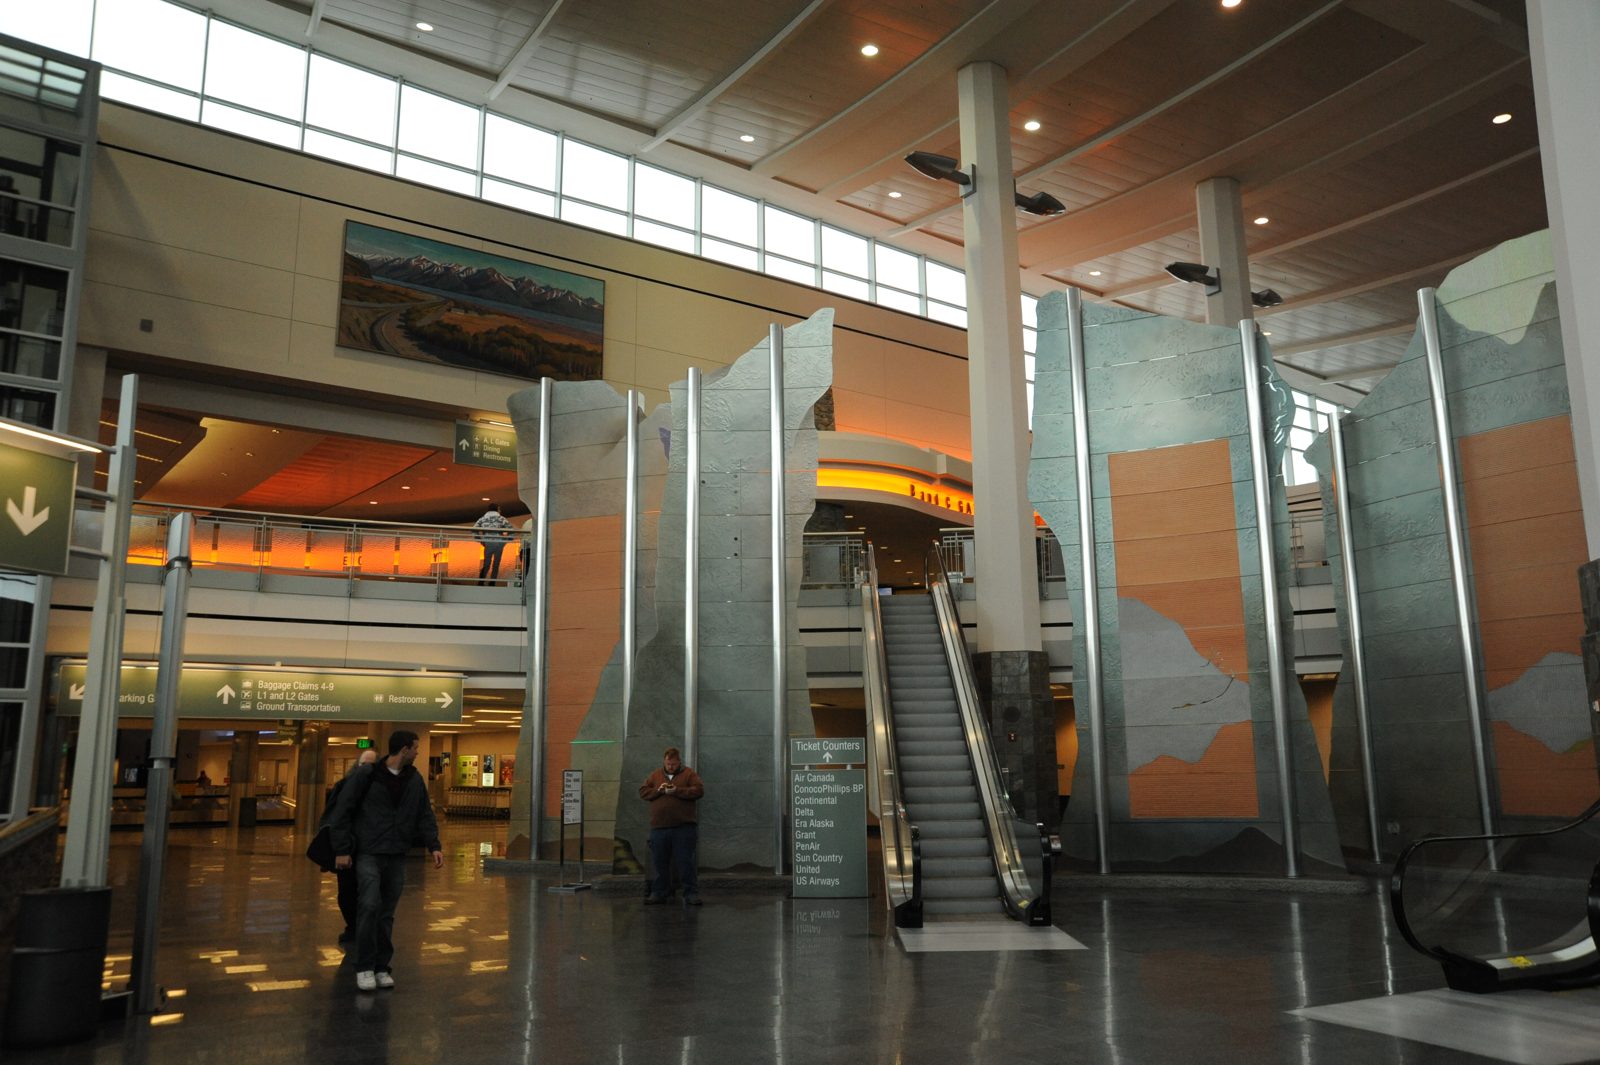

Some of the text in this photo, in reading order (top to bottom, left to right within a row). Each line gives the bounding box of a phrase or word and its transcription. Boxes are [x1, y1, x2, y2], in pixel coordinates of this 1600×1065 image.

[495, 438, 510, 446] Gates
[483, 445, 500, 453] Dining
[483, 452, 511, 462] Restrooms
[910, 484, 915, 496] B
[920, 491, 939, 505] and
[257, 680, 335, 691] Baggage Claims 4-9
[119, 694, 145, 704] arking
[257, 691, 320, 701] L1 and L2 Gates
[388, 694, 427, 704] Restrooms
[256, 702, 341, 713] Ground Transportation
[796, 740, 860, 751] Ticket Counters
[794, 772, 835, 782] Air Canada
[794, 796, 837, 805] Continental
[795, 807, 814, 816] Delta
[795, 818, 834, 828] Era Alaska
[795, 830, 816, 839] Grant
[795, 842, 821, 851] PenAir
[795, 853, 843, 864] Sun Country
[796, 865, 820, 874] United
[796, 876, 840, 887] US Airways
